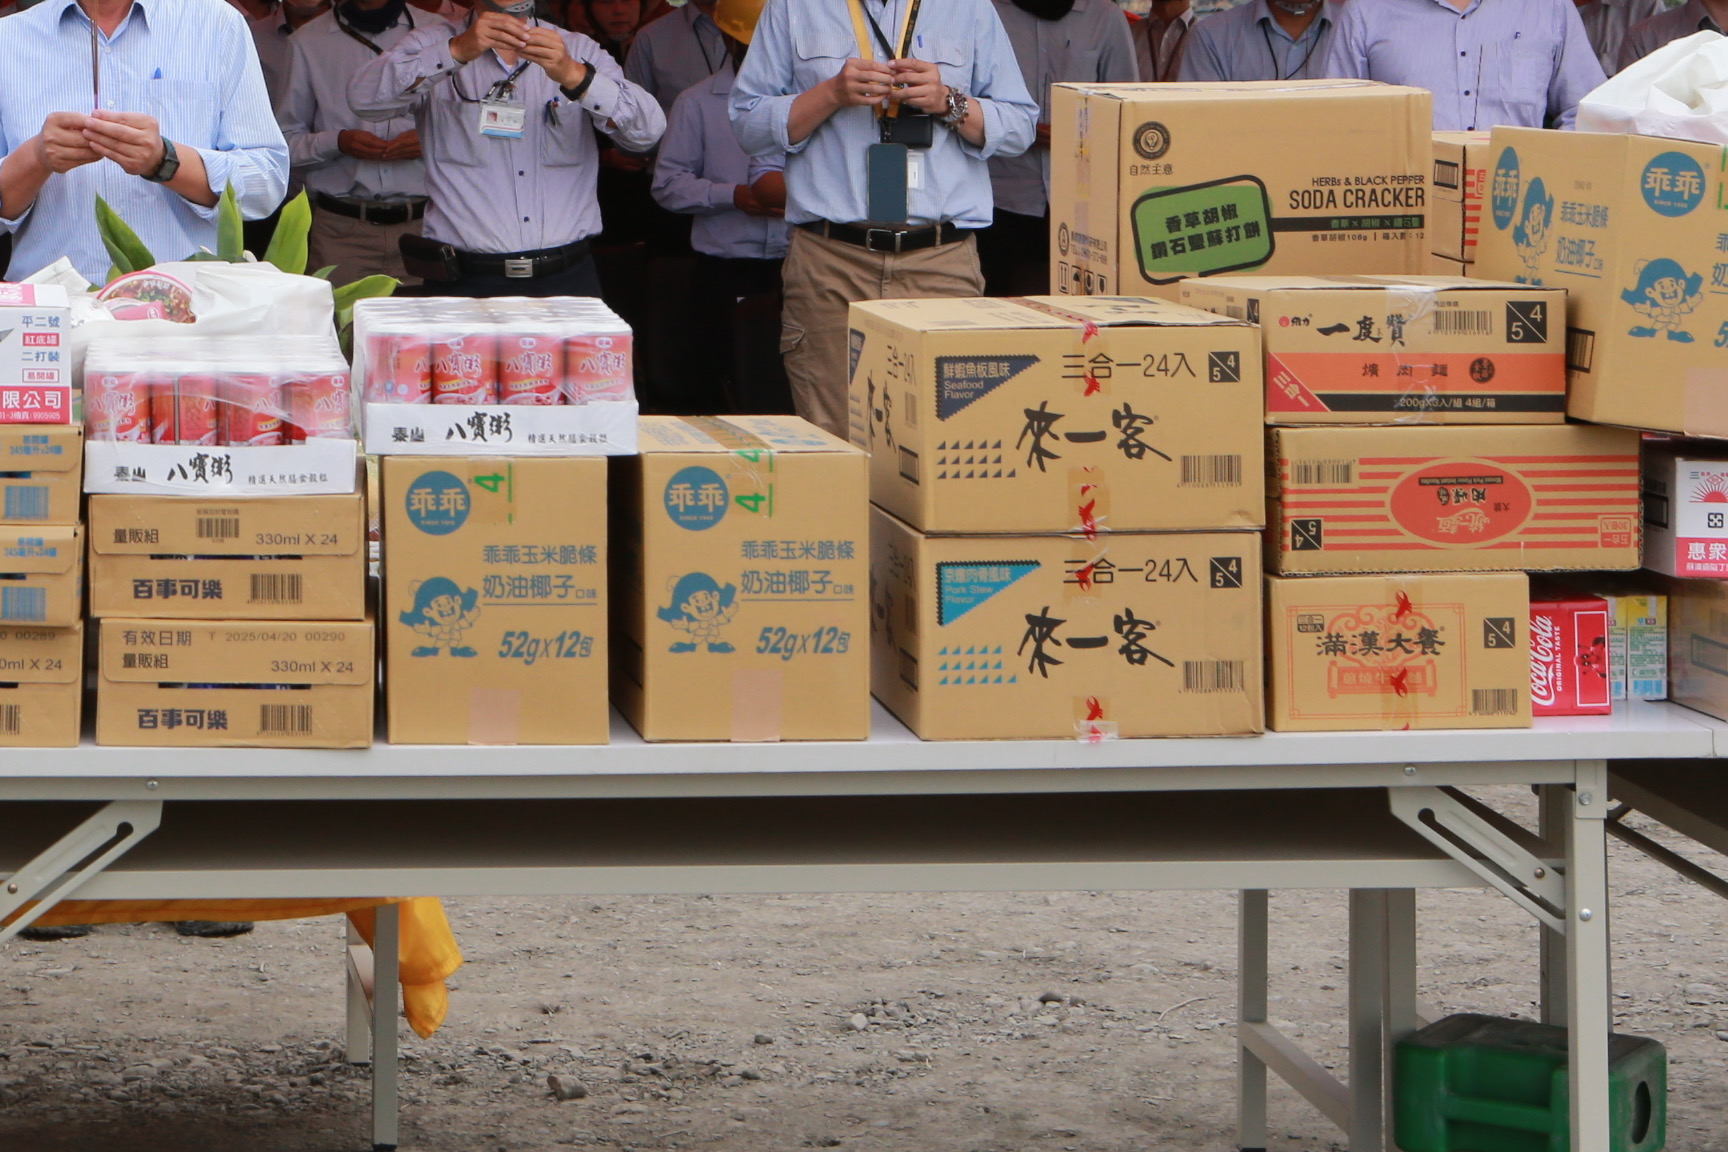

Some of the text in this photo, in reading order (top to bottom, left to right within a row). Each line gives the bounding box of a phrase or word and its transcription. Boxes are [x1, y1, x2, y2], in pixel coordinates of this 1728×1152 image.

[1129, 163, 1174, 176] 自然主意
[1312, 175, 1425, 186] HERBs & BLACK PEPPER
[1494, 168, 1519, 207] 乖乖
[1644, 166, 1702, 201] 乖乖
[1289, 187, 1425, 210] SODA CRACKER
[1165, 203, 1239, 234] 香草胡椒
[22, 315, 60, 328] 平二號
[1529, 304, 1542, 322] 4
[1511, 322, 1524, 341] 5
[21, 351, 60, 363] 二打裝
[434, 351, 482, 377] 八寶粥
[504, 350, 553, 376] 八寶粥
[579, 350, 626, 376] 八寶粥
[1061, 352, 1197, 380] 三合一24入
[1227, 355, 1237, 368] 4
[944, 380, 984, 390] Seafood
[944, 390, 975, 399] Flavor
[1273, 370, 1310, 408] 三合一
[391, 426, 425, 443] 泰山
[445, 411, 513, 443] 八寶粥
[1016, 400, 1173, 473] 來一客
[114, 466, 146, 482] 泰山
[166, 452, 233, 484] 八寶粥
[410, 487, 466, 518] 乖乖
[668, 483, 725, 513] 乖乖
[113, 528, 160, 545] 量販組
[255, 533, 338, 546] 330ml X 24
[482, 544, 598, 565] 乖乖玉米脆條
[740, 540, 856, 561] 乖乖玉米脆條
[1062, 557, 1199, 584] 三合一24入
[132, 578, 223, 600] 百事可樂
[482, 574, 598, 599] 奶油椰子口味
[740, 570, 856, 595] 奶油椰子口味
[15, 630, 56, 641] 00289
[122, 630, 193, 647] 有效日期
[225, 631, 298, 642] 2025/04/20
[305, 631, 346, 642] 00290
[1017, 605, 1176, 679] 來一客
[1315, 626, 1446, 657] 滿漢大餐
[29, 659, 40, 671] X
[45, 659, 63, 671] 24
[122, 653, 170, 670] 量販組
[1554, 625, 1563, 692] ORIGINAL TASTE
[137, 708, 228, 730] 百事可樂
